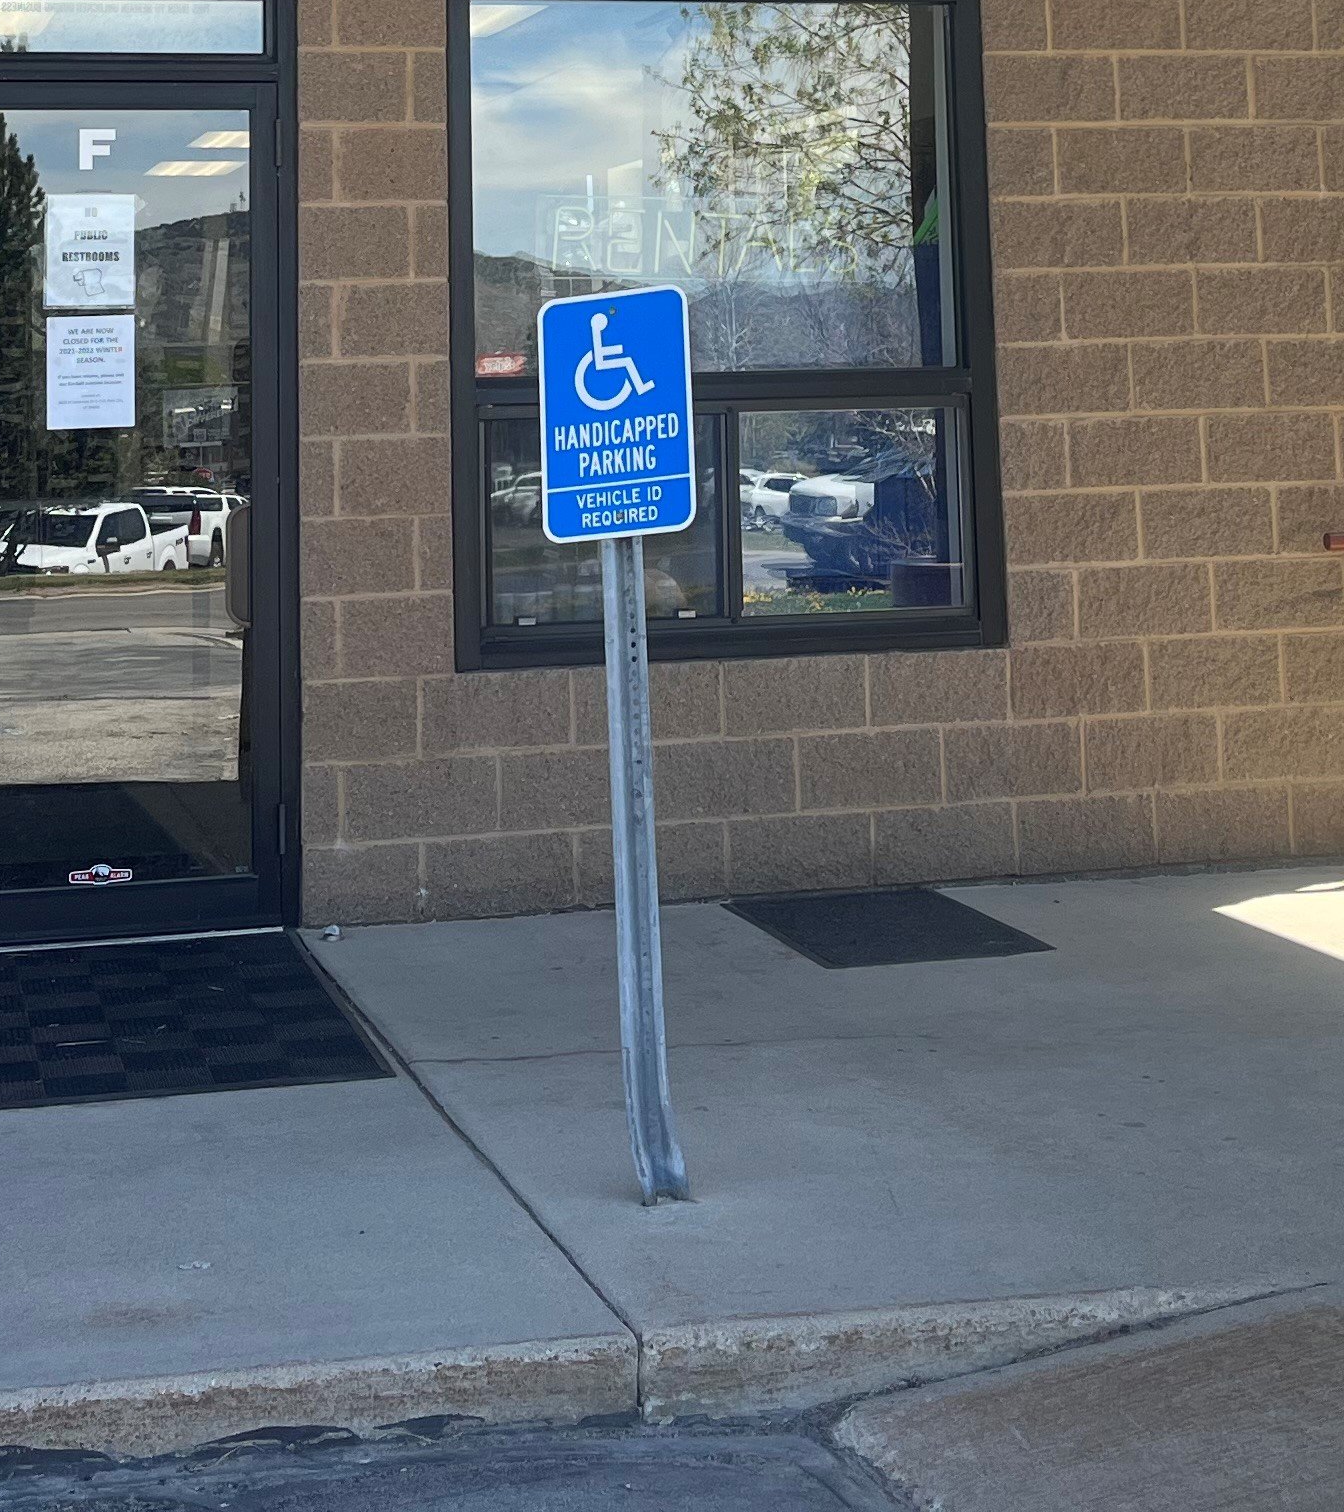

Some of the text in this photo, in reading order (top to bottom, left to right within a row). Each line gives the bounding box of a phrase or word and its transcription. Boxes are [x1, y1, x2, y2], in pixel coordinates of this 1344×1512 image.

[79, 128, 117, 170] F
[84, 207, 98, 218] NO
[74, 229, 109, 241] PUBLIC
[552, 206, 858, 275] RENTALS
[62, 251, 120, 262] RESTROOMS
[96, 346, 123, 354] WINTER
[555, 412, 679, 451] HANDICAPPED
[579, 444, 657, 478] PARKING
[576, 485, 662, 509] VEHICLE ID
[581, 505, 658, 528] REQUIRED
